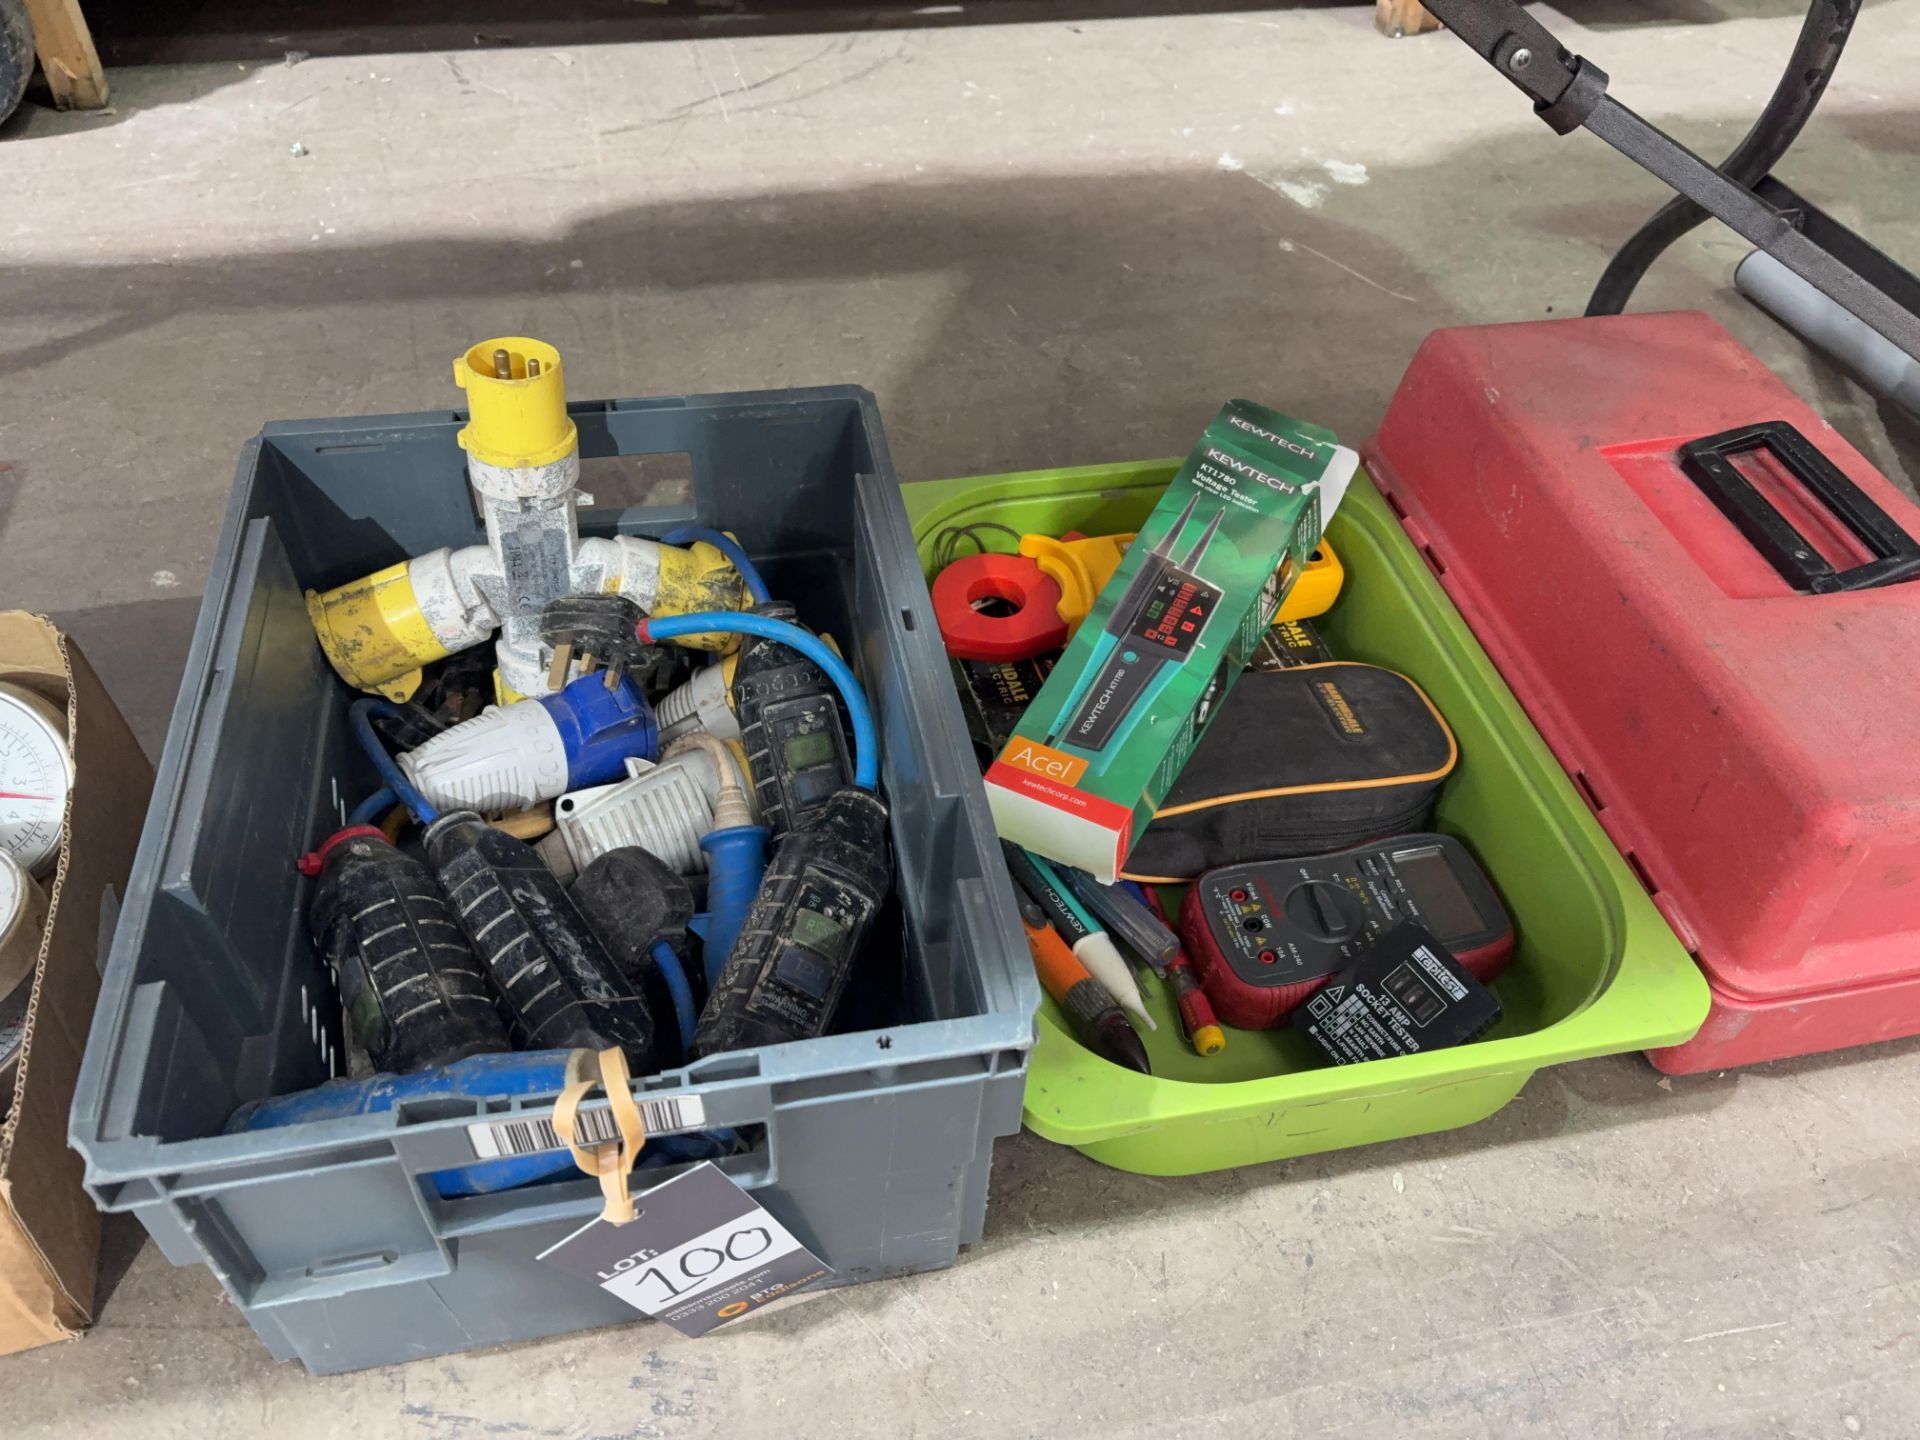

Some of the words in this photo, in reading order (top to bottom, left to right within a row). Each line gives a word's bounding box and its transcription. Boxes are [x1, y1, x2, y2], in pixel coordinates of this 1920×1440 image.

[1230, 417, 1315, 459] KEWTECH
[1200, 463, 1236, 485] KT1780
[1208, 448, 1295, 494] KEWTECH
[1196, 471, 1228, 492] Voltage
[1230, 487, 1258, 505] Tester
[1219, 491, 1232, 501] LED
[1079, 689, 1113, 734] KEWTECH
[1110, 668, 1126, 690] KT1780
[1012, 747, 1073, 779] Acel
[13, 776, 27, 786] 3
[1023, 778, 1088, 808] kewtechcorp.com
[7, 810, 20, 820] 4
[40, 834, 50, 846] 60
[1366, 859, 1380, 876] SELECT
[1045, 888, 1085, 932] KEWTECH
[1261, 914, 1273, 929] COM
[1419, 952, 1461, 995] rapitest
[1356, 983, 1390, 1018] SOCKET
[1387, 1018, 1420, 1052] TESTER
[1378, 994, 1390, 1006] 13
[1389, 1006, 1411, 1027] AMP
[1353, 1034, 1369, 1051] FAULT
[1360, 1018, 1369, 1028] NO
[1369, 1027, 1386, 1046] EARTH
[1366, 1014, 1401, 1053] CORRECT/FUSE
[1330, 1050, 1339, 1060] ON
[596, 1248, 660, 1280] LOT:
[635, 1227, 772, 1303] 100
[672, 1304, 705, 1321] 0333
[703, 1293, 731, 1307] 200
[733, 1278, 763, 1296] 2041
[751, 1283, 784, 1300] BTG
